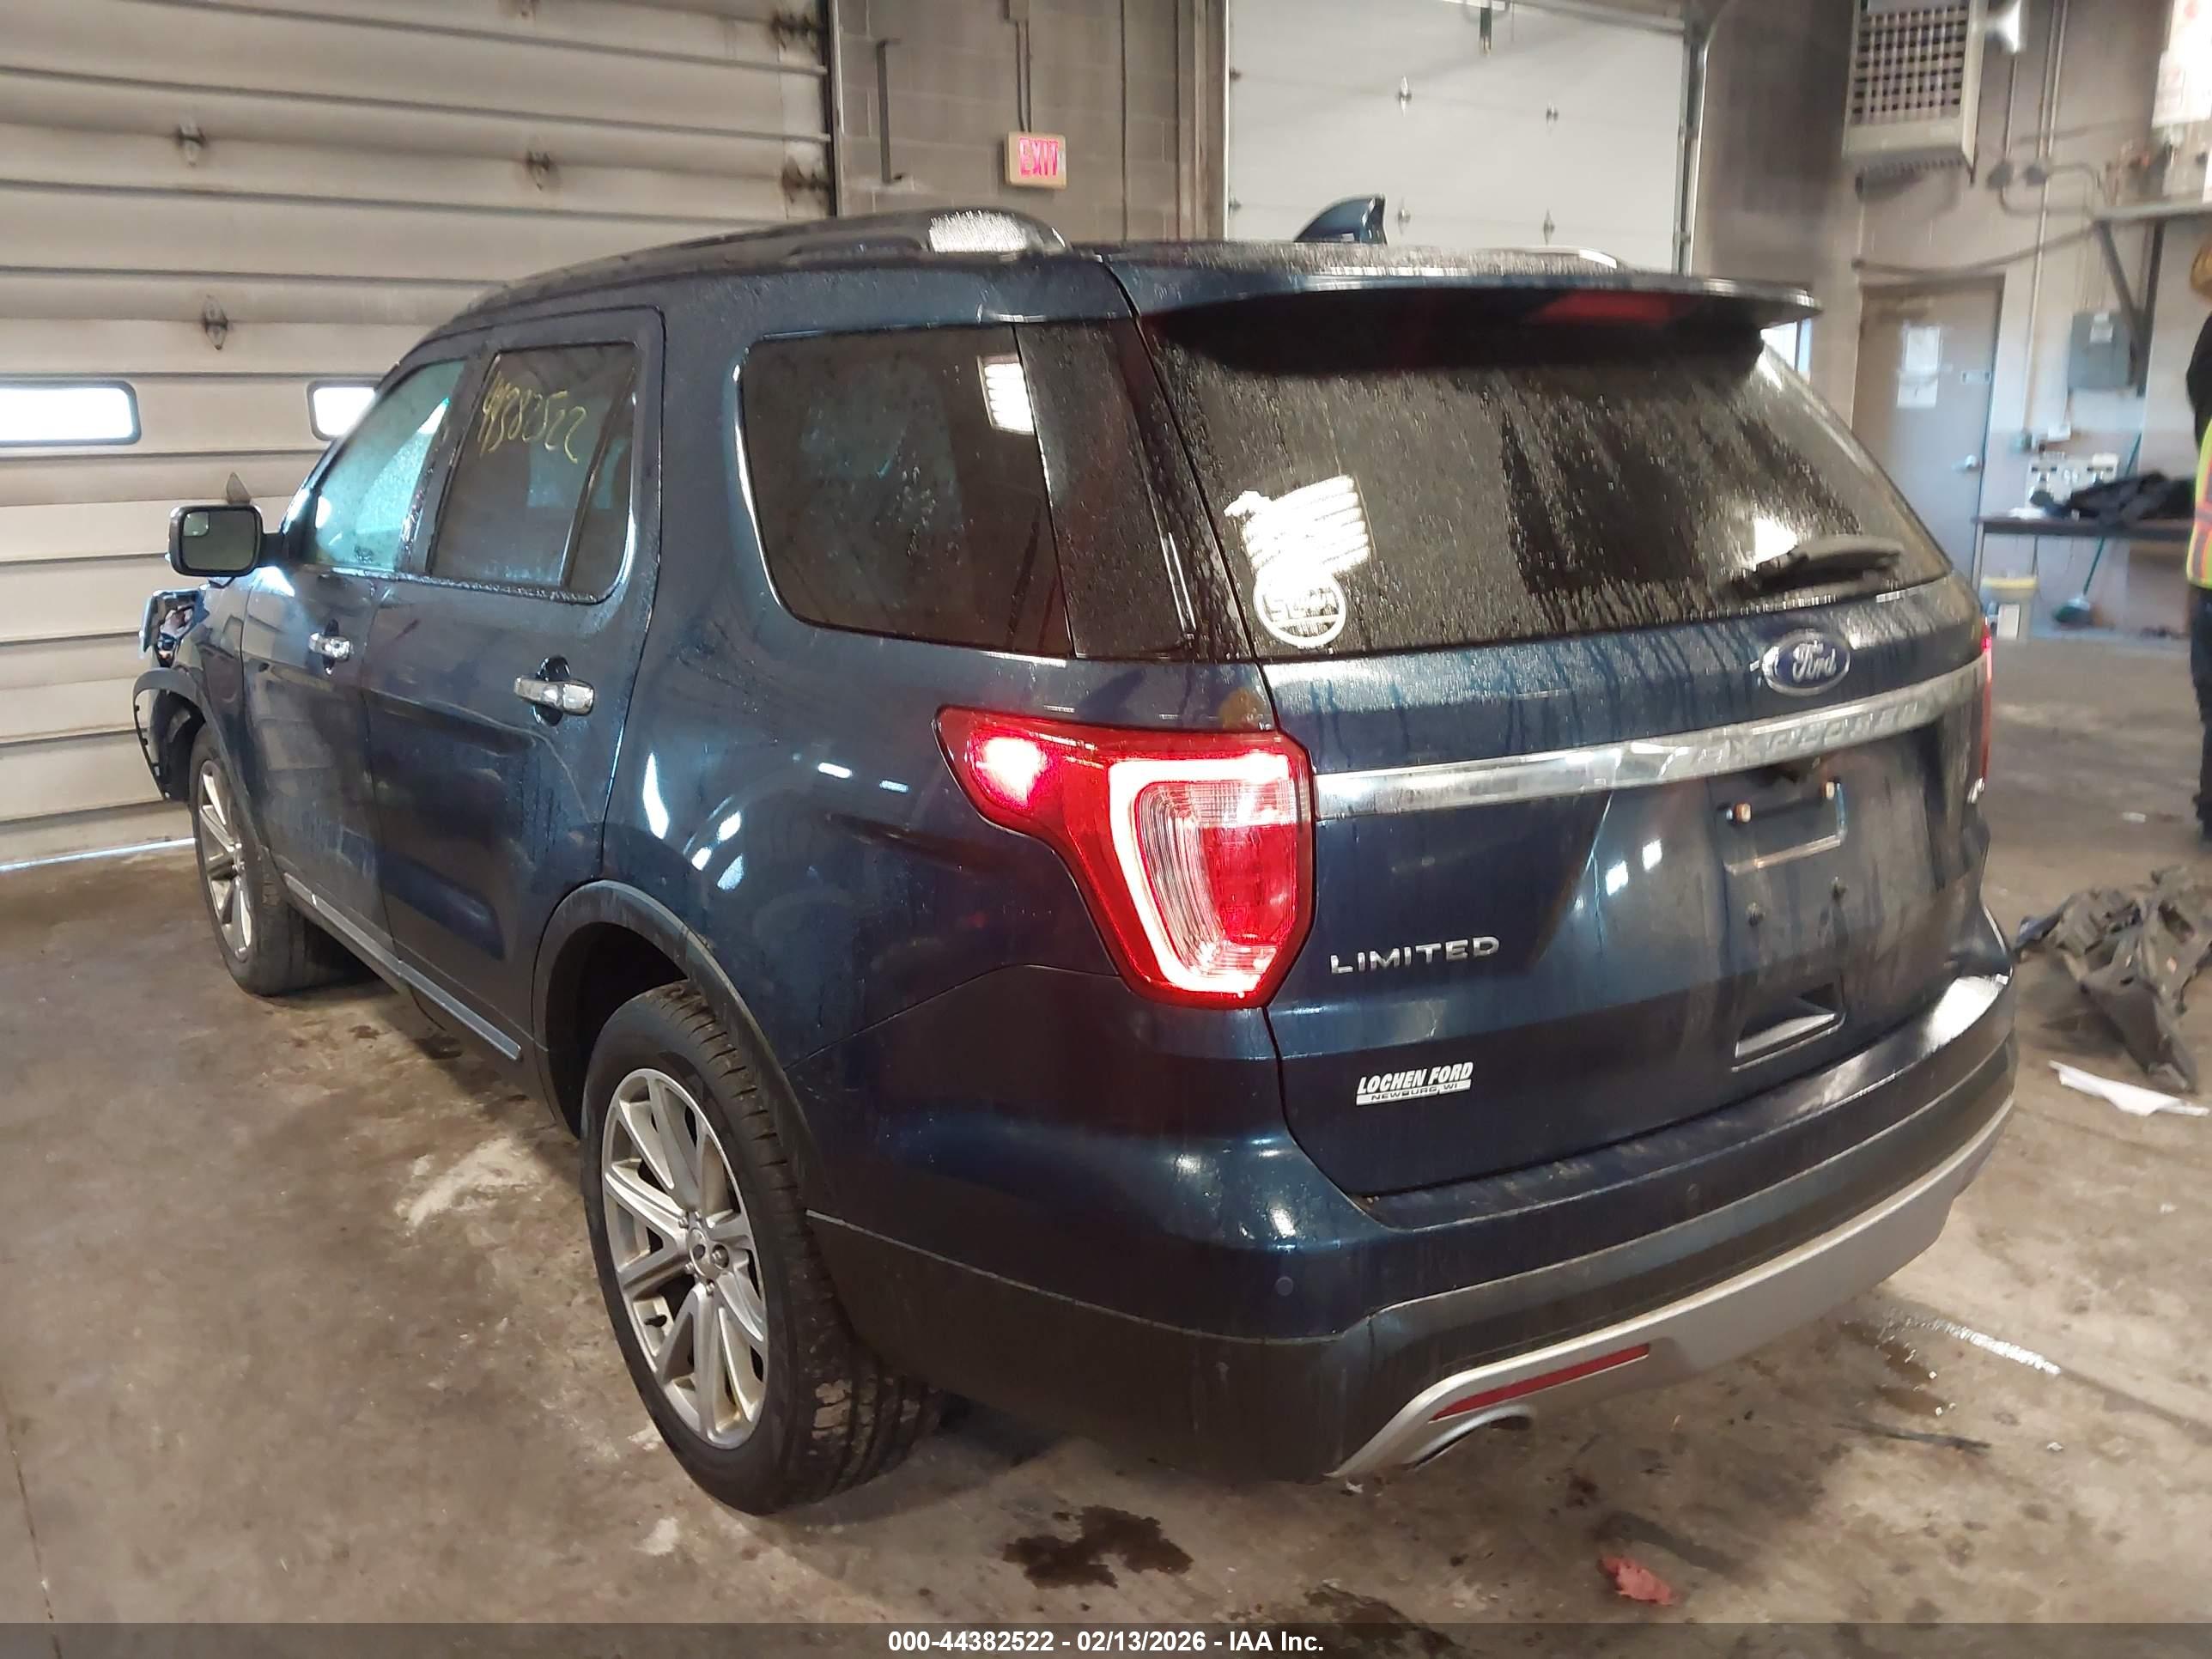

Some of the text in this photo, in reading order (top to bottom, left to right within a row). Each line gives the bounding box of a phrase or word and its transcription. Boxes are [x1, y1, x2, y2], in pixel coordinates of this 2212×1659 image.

[1019, 137, 1058, 176] EXIT
[1792, 640, 1838, 684] Ford
[1330, 936, 1500, 975] LIMITED
[1357, 1061, 1474, 1095] LOCHEN FORD
